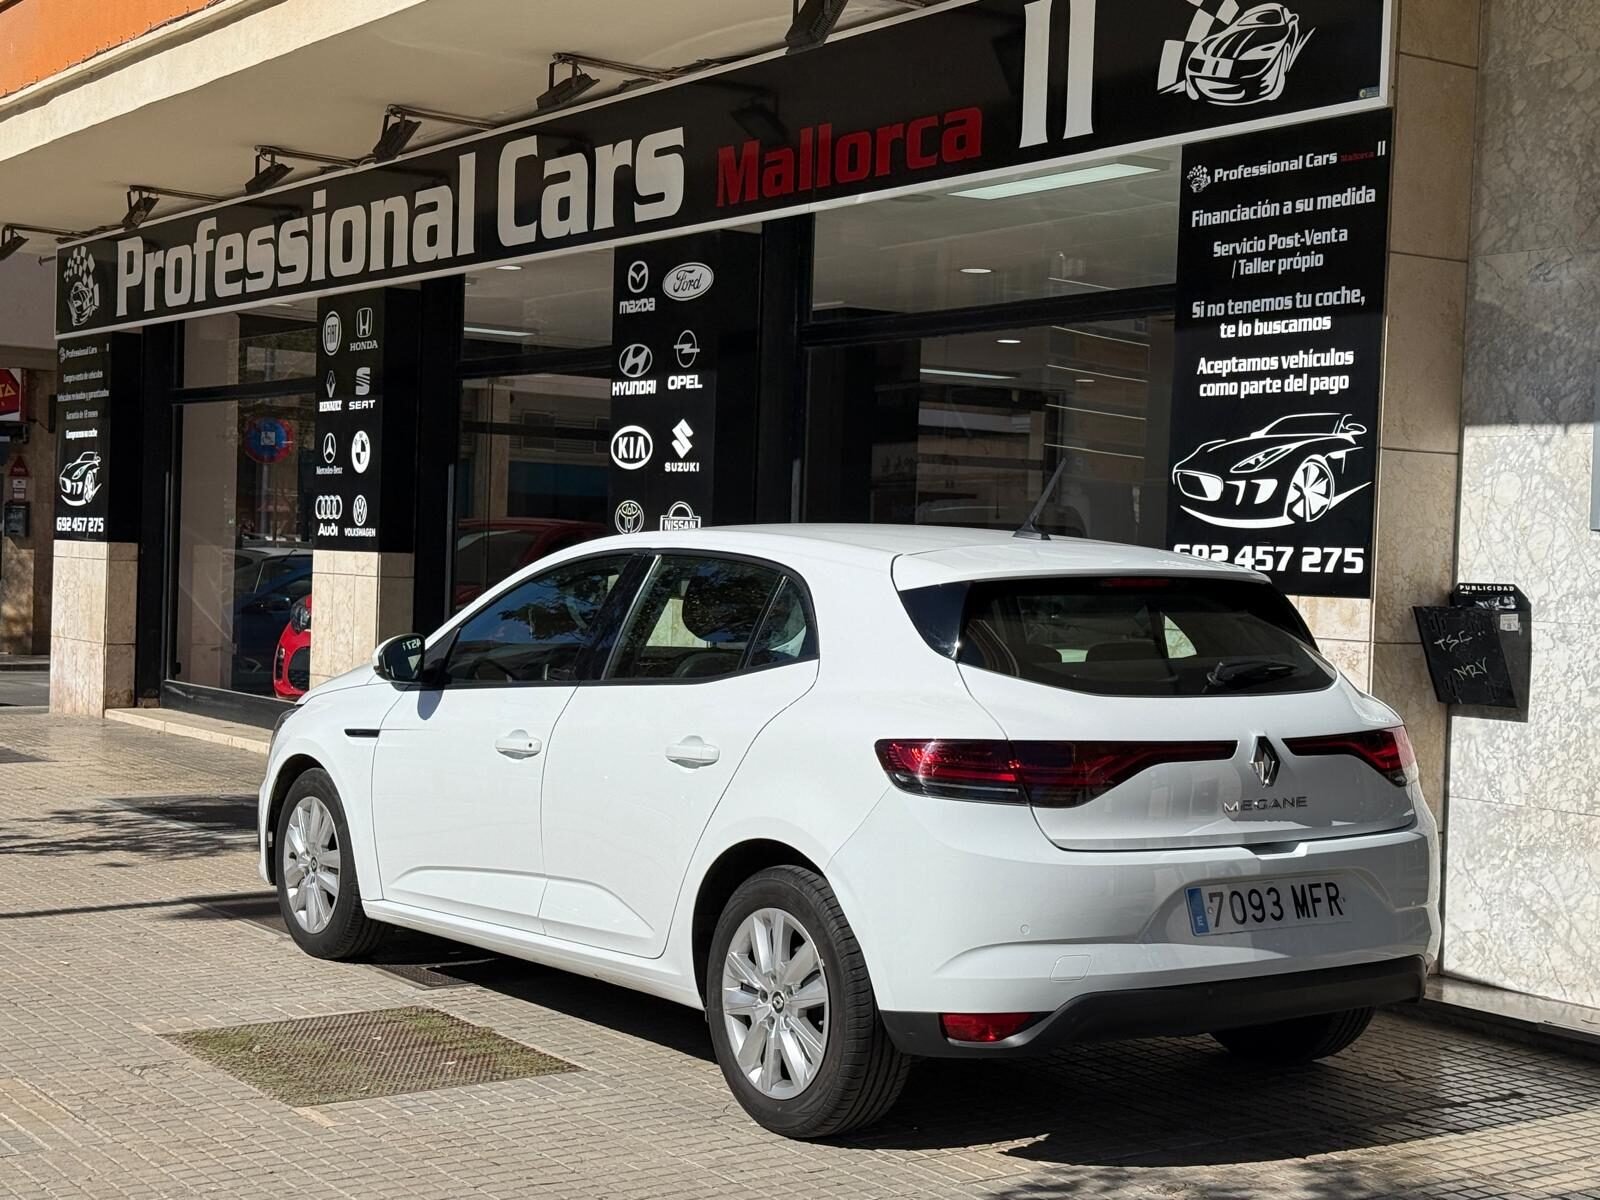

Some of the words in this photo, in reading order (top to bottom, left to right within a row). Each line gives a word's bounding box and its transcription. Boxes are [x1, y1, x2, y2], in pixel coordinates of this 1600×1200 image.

[1214, 155, 1303, 183] Professional
[1305, 152, 1338, 168] Cars
[116, 152, 476, 317] Professional
[497, 126, 685, 247] Cars
[715, 106, 983, 208] Mallorca
[1191, 200, 1280, 228] Financiación
[1283, 201, 1292, 215] a
[1295, 197, 1314, 213] su
[1316, 185, 1376, 210] medida
[1213, 236, 1266, 257] Servicio
[1268, 227, 1348, 251] Post-Venta
[1278, 251, 1324, 275] própio
[673, 269, 703, 293] Ford
[619, 297, 656, 315] mazda
[1192, 301, 1205, 319] Si
[1207, 303, 1225, 317] no
[1227, 295, 1293, 315] tenemos
[1295, 292, 1312, 309] tu
[1315, 286, 1366, 307] coche,
[1220, 323, 1236, 339] te
[1238, 320, 1252, 337] lo
[1254, 316, 1332, 336] buscamos
[349, 340, 379, 352] HONDA
[1196, 356, 1279, 378] Aceptamos
[1281, 348, 1354, 370] vehículos
[612, 380, 657, 396] HYUNDAI
[667, 375, 703, 390] OPEL
[1199, 382, 1238, 397] como
[1240, 377, 1282, 399] parte
[1284, 373, 1307, 393] del
[1310, 375, 1350, 395] pago
[348, 400, 376, 411] SEAT
[618, 435, 646, 459] KIA
[664, 462, 700, 472] SUZUKI
[56, 517, 71, 532] 692
[72, 517, 87, 532] 457
[88, 517, 104, 532] 275
[317, 522, 339, 536] Audi
[664, 519, 696, 530] NISSAN
[1234, 545, 1294, 572] 457
[1301, 547, 1365, 574] 275
[1459, 584, 1515, 592] PUBLICIDAD
[1223, 796, 1308, 814] MEGANE
[1208, 886, 1285, 928] 7093
[1290, 881, 1344, 920] MFR
